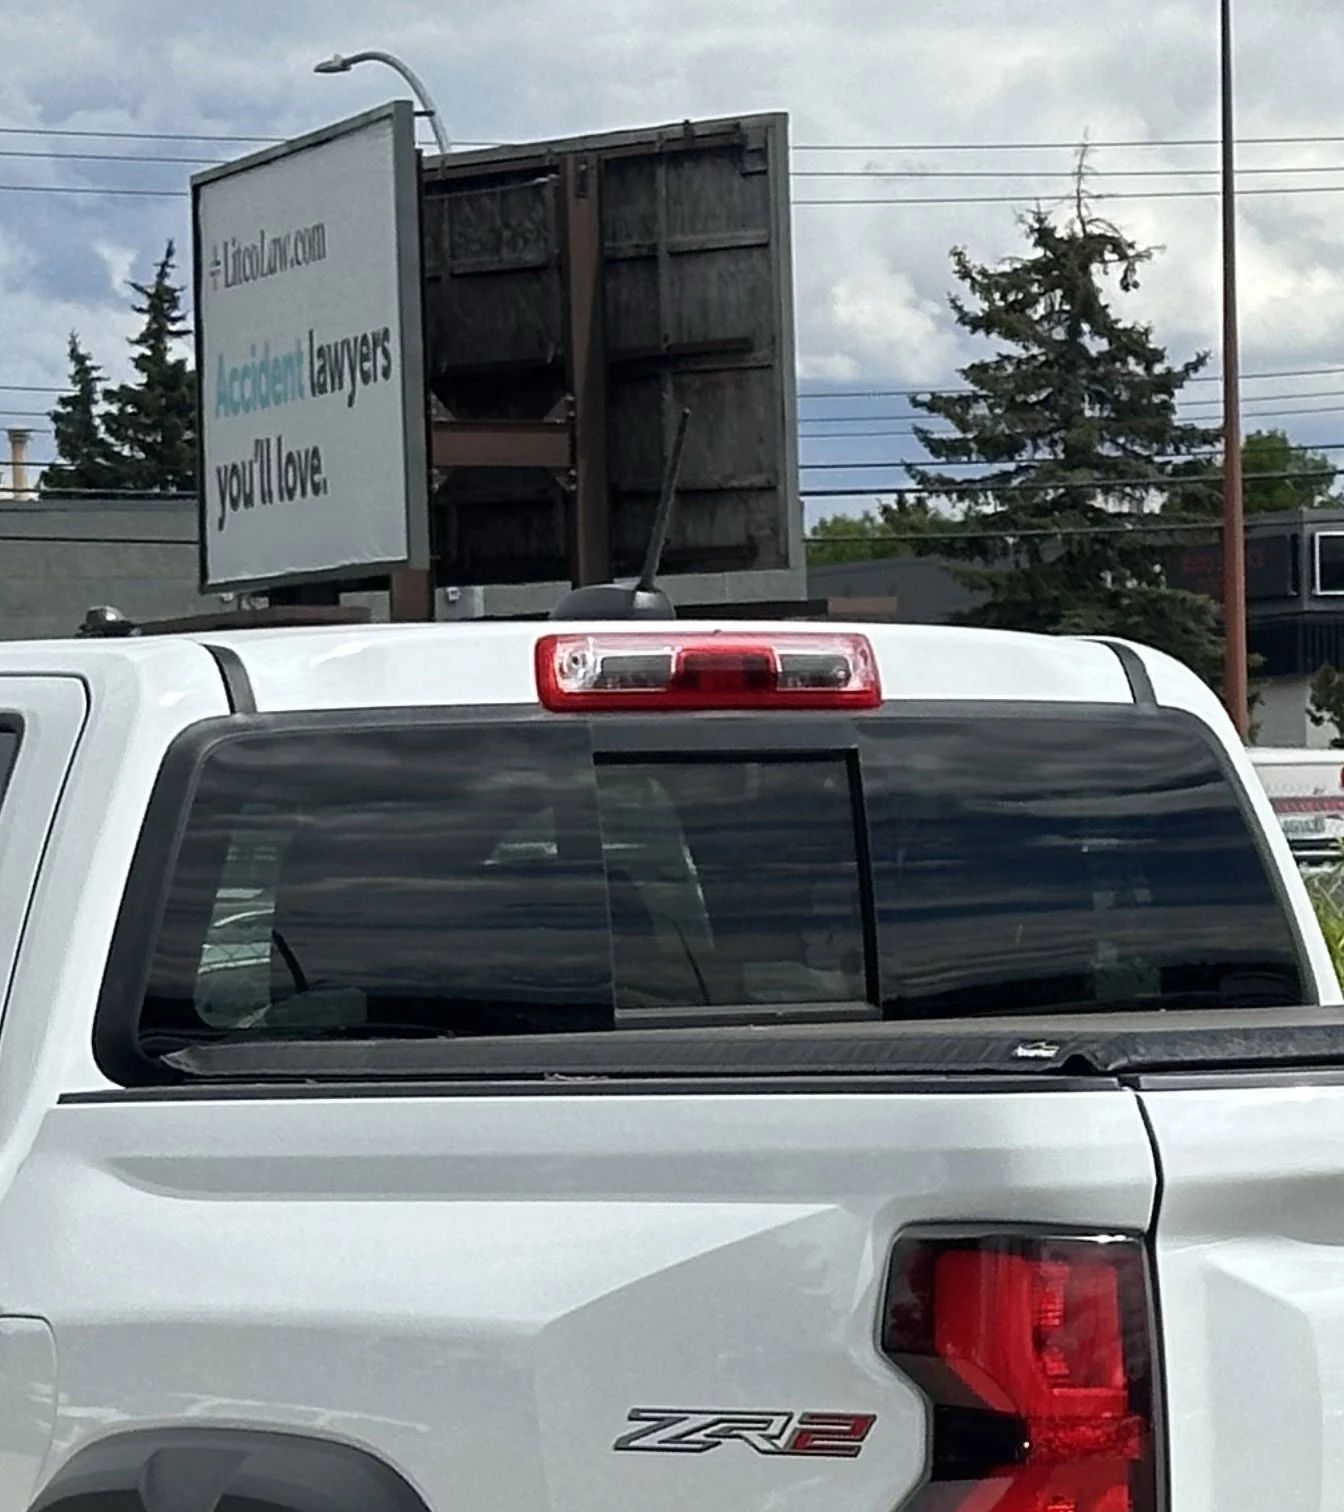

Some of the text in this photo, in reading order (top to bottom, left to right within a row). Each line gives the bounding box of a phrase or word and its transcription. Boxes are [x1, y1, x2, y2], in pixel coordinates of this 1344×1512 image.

[215, 327, 391, 419] Accident lawyers
[216, 435, 328, 531] you'll love.
[613, 1407, 877, 1458] ZR2
